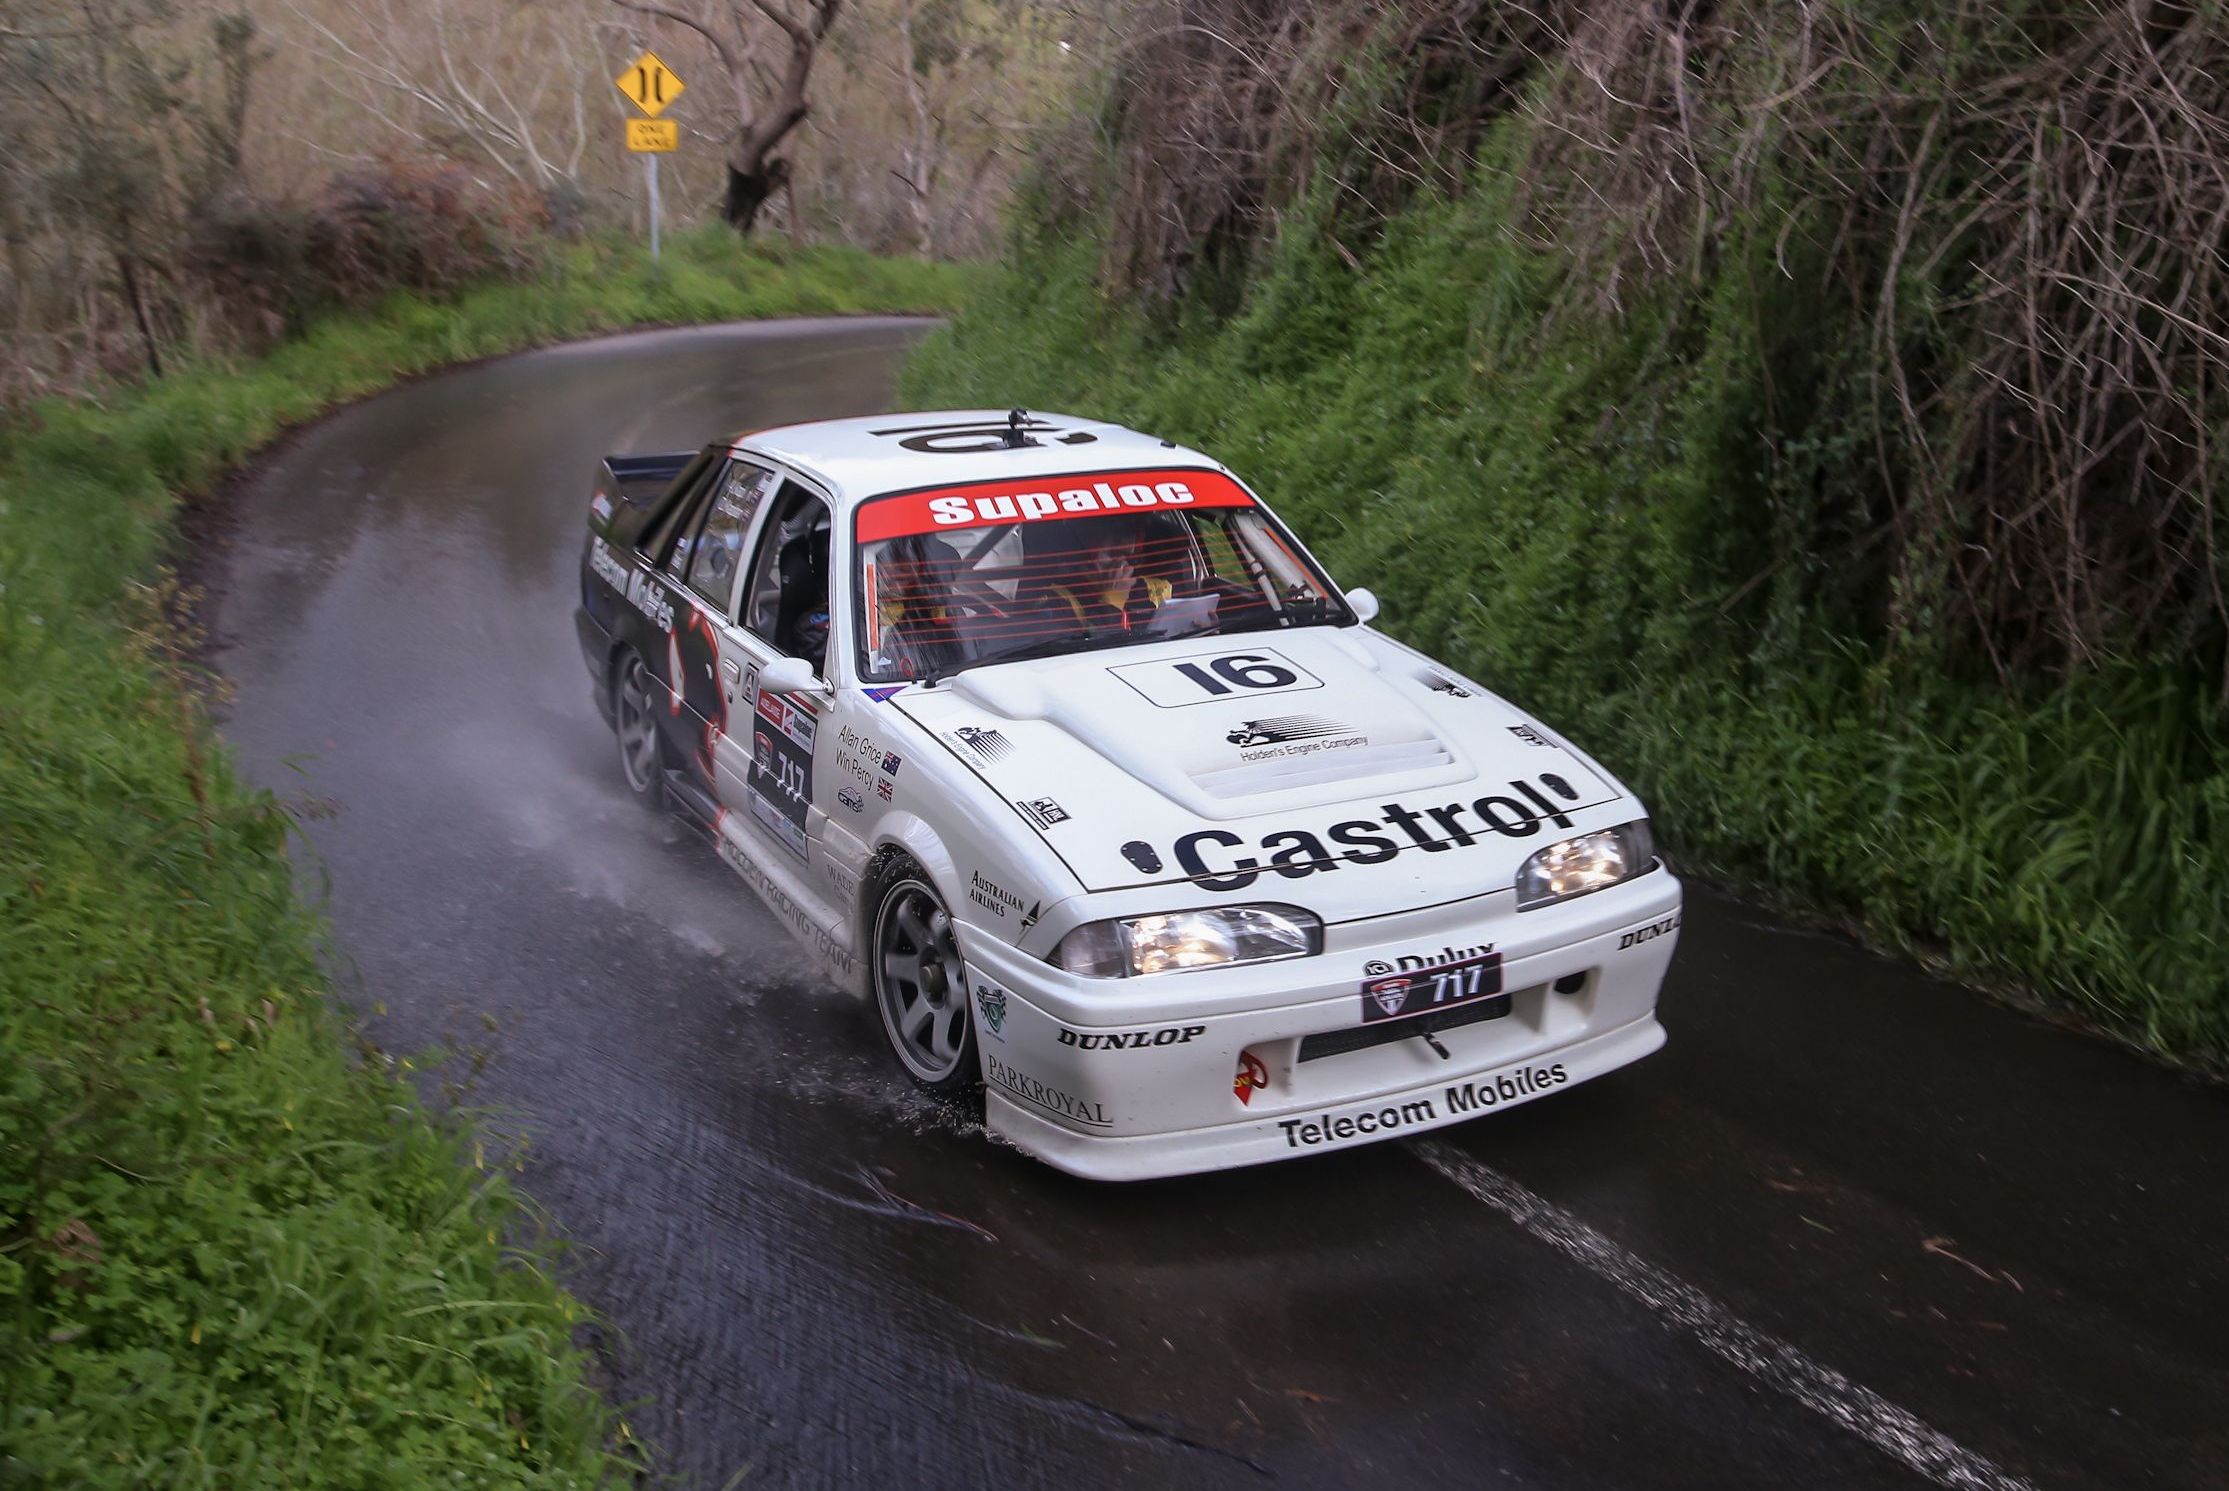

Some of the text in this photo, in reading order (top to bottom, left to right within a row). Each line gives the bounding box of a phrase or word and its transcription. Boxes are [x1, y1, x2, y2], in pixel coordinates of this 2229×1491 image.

[928, 481, 1194, 525] Supaloc
[1172, 655, 1297, 696] 16
[838, 725, 859, 750] Allan
[859, 738, 882, 764] Grice
[1240, 736, 1369, 762] Holden's Engine Company
[777, 752, 804, 803] 717
[836, 748, 874, 791] Win Percy
[1174, 780, 1575, 892] Castrol
[969, 888, 1005, 917] AIRLINES
[971, 870, 1024, 912] AUSTRALIAN
[1430, 964, 1483, 1002] 717
[1057, 1025, 1206, 1050] DUNLOP
[988, 1055, 1113, 1123] PARKROYAL
[1278, 1063, 1568, 1148] Telecom Mobiles
